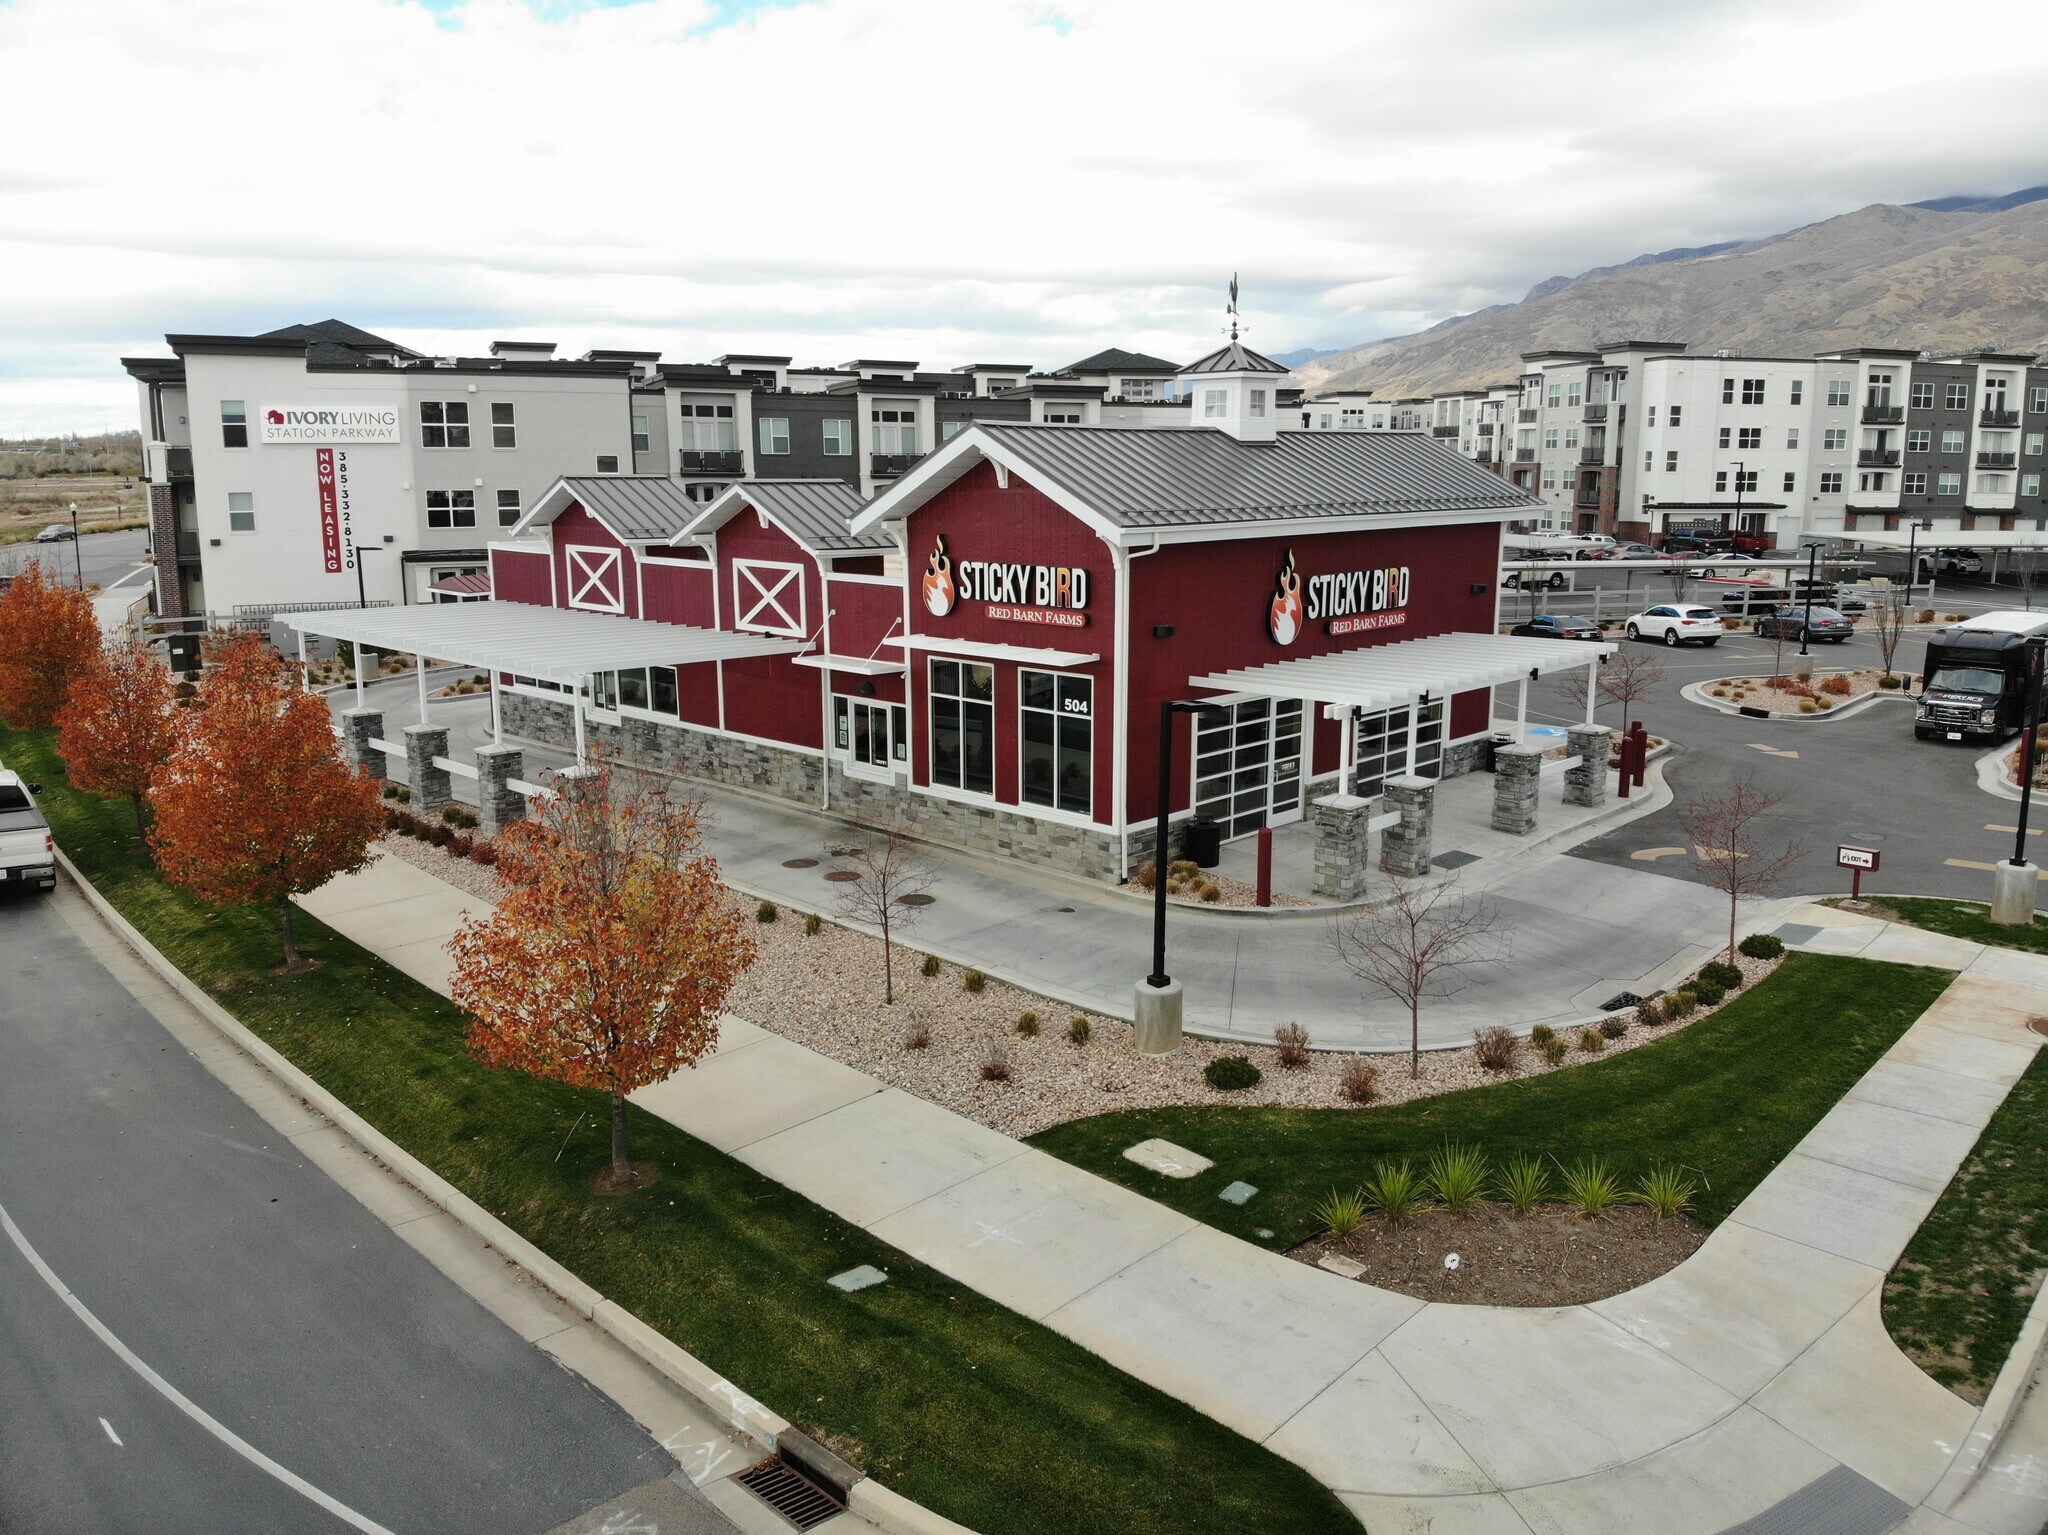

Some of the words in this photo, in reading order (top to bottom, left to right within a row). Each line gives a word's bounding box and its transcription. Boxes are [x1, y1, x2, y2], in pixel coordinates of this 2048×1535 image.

[267, 428, 326, 438] STATION
[332, 428, 394, 438] PARKWAY
[319, 452, 332, 484] NOW
[323, 492, 338, 570] LEASING
[959, 560, 1031, 604] STICKY
[1035, 565, 1087, 609] BIRD
[1308, 570, 1370, 619] STICKY
[1372, 566, 1409, 610] BIRD
[988, 606, 1011, 619] RED
[1013, 608, 1043, 622] BARN
[1045, 612, 1083, 626] FARMS
[1332, 621, 1351, 634] RED
[1353, 617, 1377, 631] BARN
[1378, 613, 1405, 627] FARMS
[1064, 698, 1088, 714] 504
